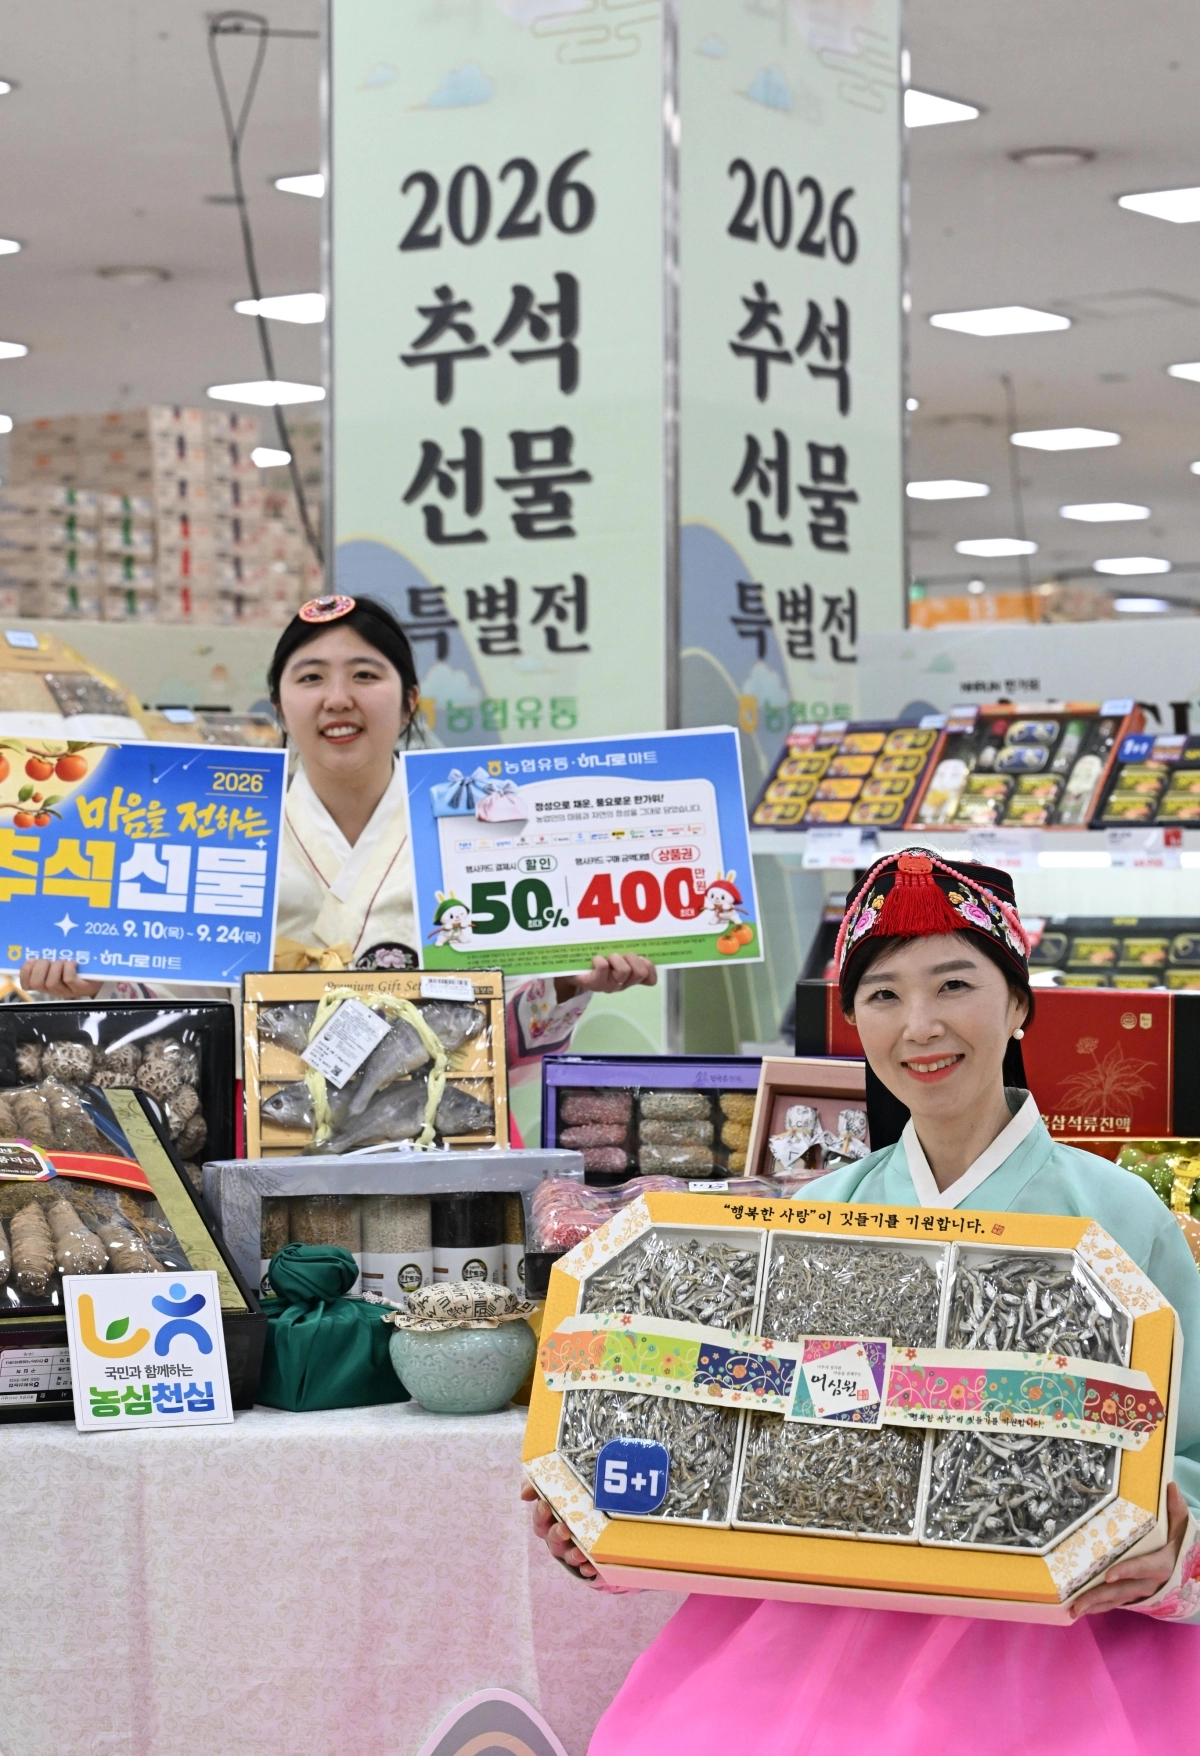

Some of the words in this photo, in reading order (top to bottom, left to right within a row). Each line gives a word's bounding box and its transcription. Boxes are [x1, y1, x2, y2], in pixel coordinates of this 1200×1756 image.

[398, 149, 596, 253] 2026
[727, 157, 858, 266] 2026
[399, 270, 580, 406] 추석
[728, 280, 850, 418] 추석
[402, 425, 593, 546] 선물
[731, 428, 859, 554] 선물
[398, 573, 591, 661] 특별전
[730, 580, 857, 664] 특별전
[446, 696, 578, 733] 농협유통
[504, 757, 569, 775] 농협유통
[576, 751, 658, 769] 하나로마트
[212, 772, 264, 793] 2026
[76, 786, 171, 839] 마음을
[176, 801, 272, 840] 전하는
[535, 801, 571, 811] 정성으로
[596, 796, 631, 807] 풍요로운
[658, 848, 693, 861] 상품권
[84, 922, 120, 936] 2026.
[123, 920, 138, 938] 9.
[143, 921, 184, 940] 10(목)
[197, 925, 212, 942] 9.
[216, 926, 261, 944] 24(목)
[100, 950, 182, 970] 하나로마트
[378, 980, 401, 993] Gift
[840, 1211, 900, 1228] 깃들기를
[905, 1214, 985, 1235] 기원합니다.
[104, 1365, 142, 1380] 국민과
[144, 1364, 194, 1379] 함께하는
[811, 1373, 857, 1397] 어심원
[89, 1381, 215, 1417] 농심천심
[604, 1459, 659, 1497] 5+1
